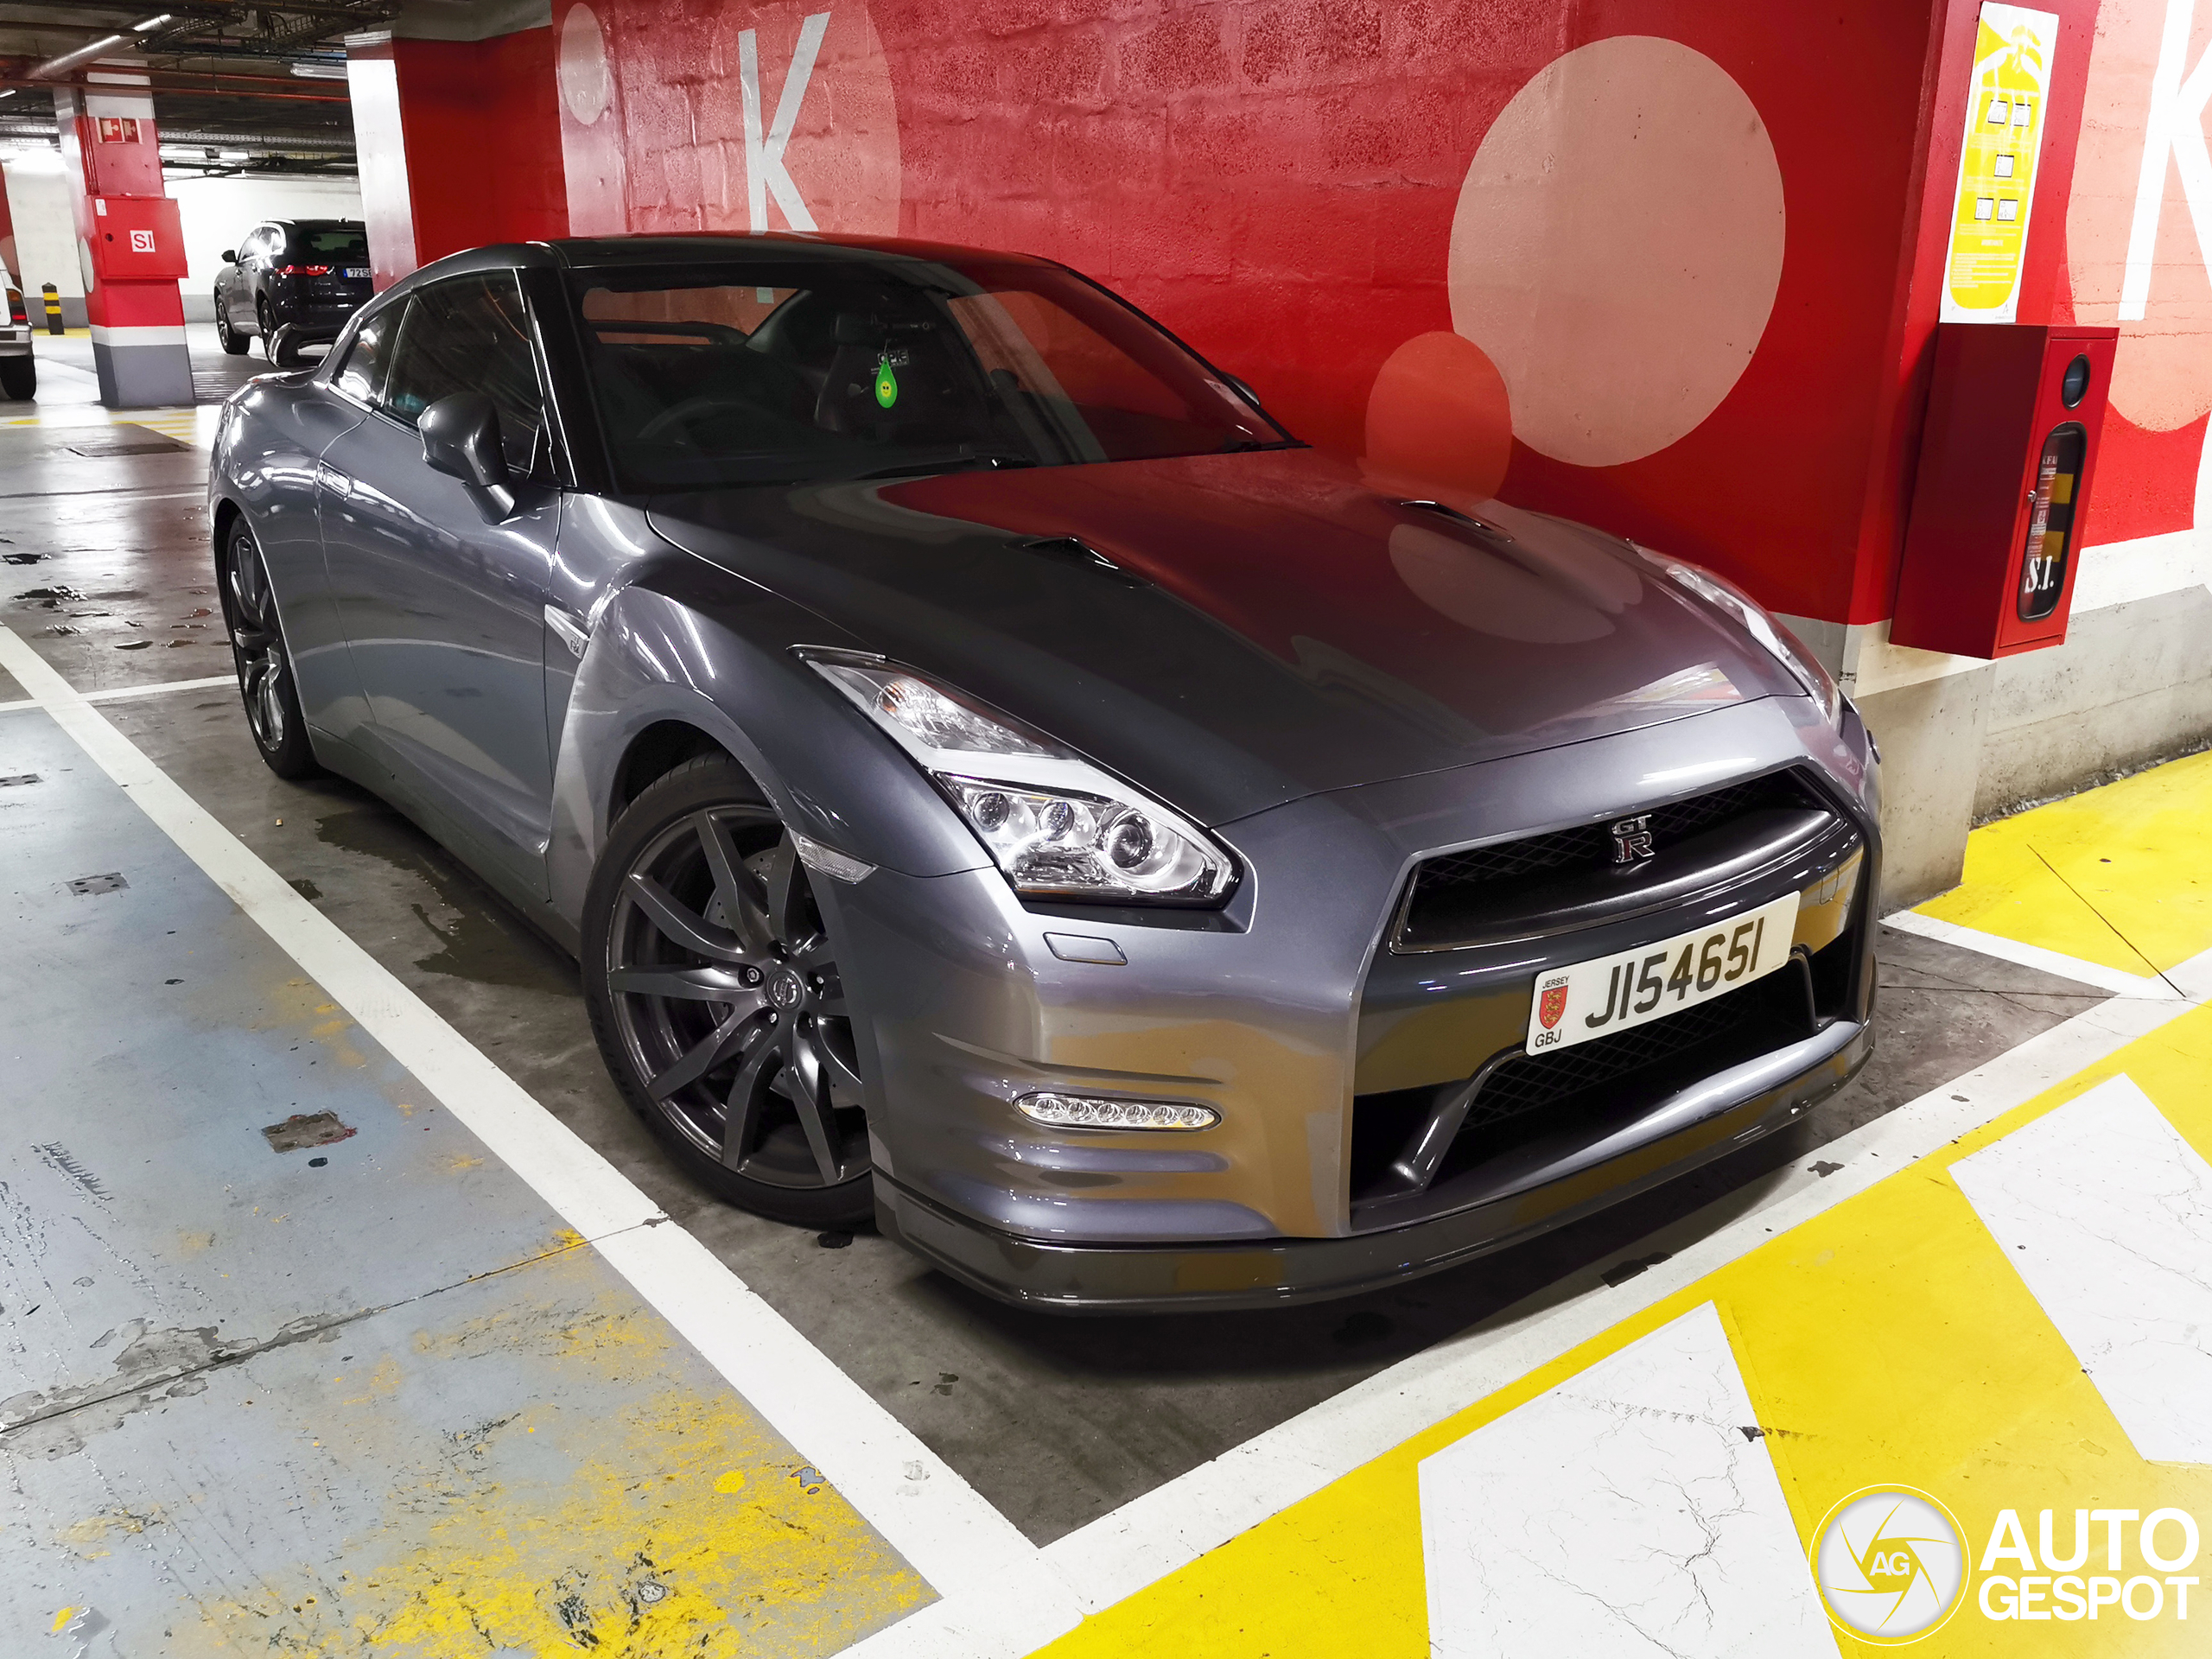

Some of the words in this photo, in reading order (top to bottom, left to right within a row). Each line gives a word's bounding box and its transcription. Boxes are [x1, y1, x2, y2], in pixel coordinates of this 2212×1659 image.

[738, 11, 831, 235] K
[2117, 0, 2212, 321] K
[134, 233, 153, 249] SI
[2024, 556, 2054, 594] S.I.
[1611, 814, 1652, 835] GT
[1614, 831, 1656, 863] R
[1542, 975, 1570, 989] JERSEY
[1585, 916, 1765, 1028] J154651
[1535, 1028, 1562, 1048] GBJ
